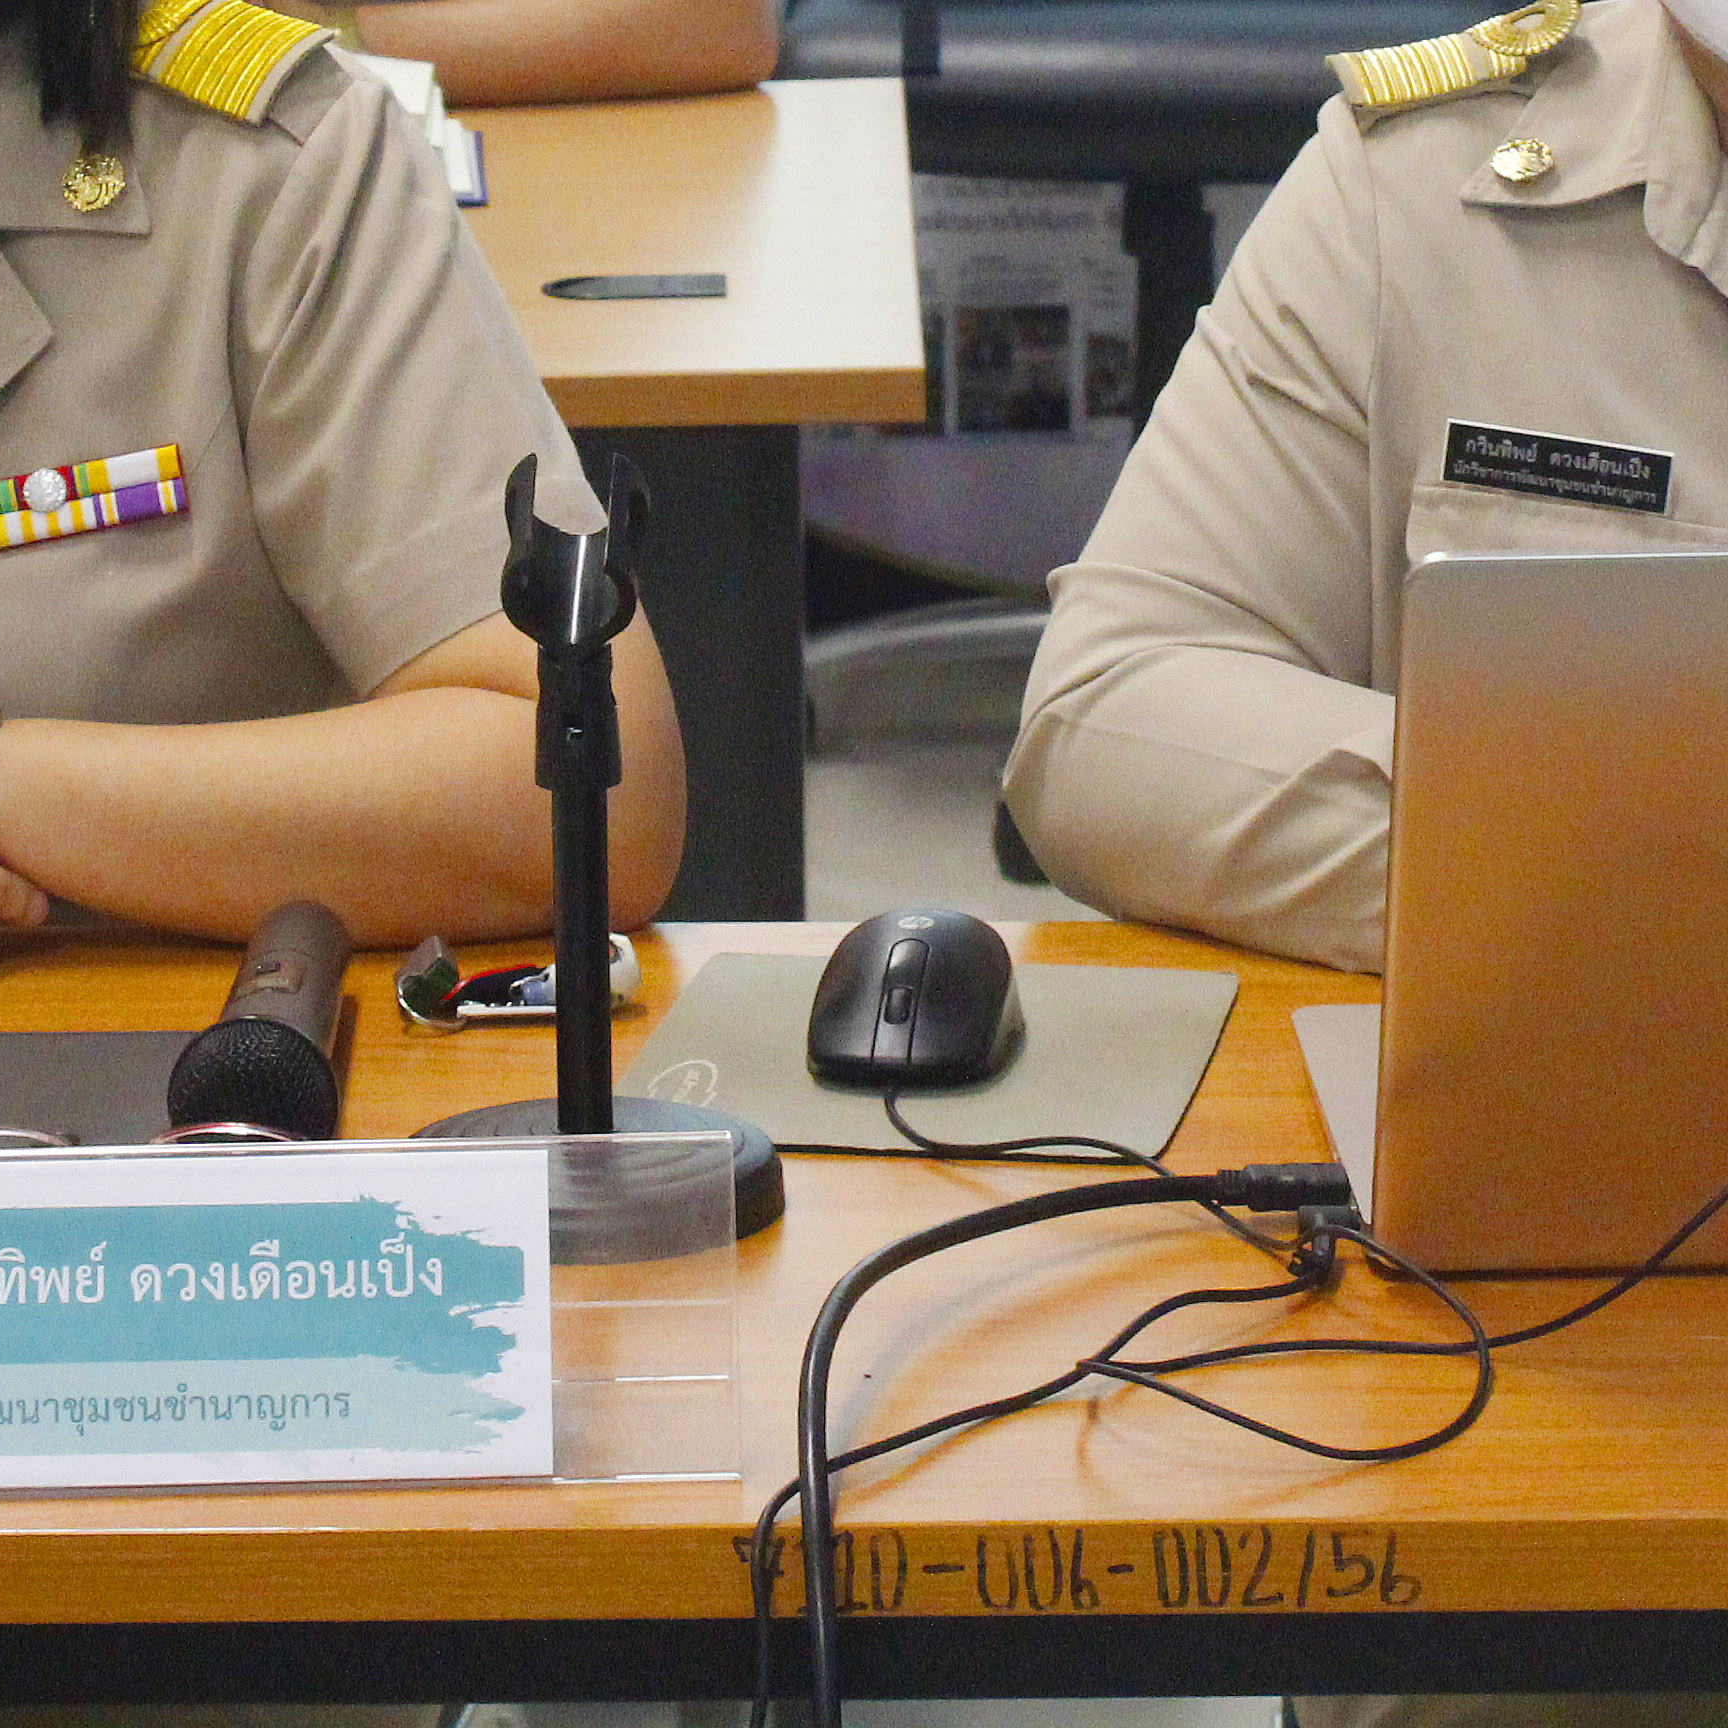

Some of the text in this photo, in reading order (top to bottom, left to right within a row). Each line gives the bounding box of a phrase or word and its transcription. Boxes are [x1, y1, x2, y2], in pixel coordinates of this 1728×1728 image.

[129, 1233, 445, 1304] ดวงเดือนเป็ง
